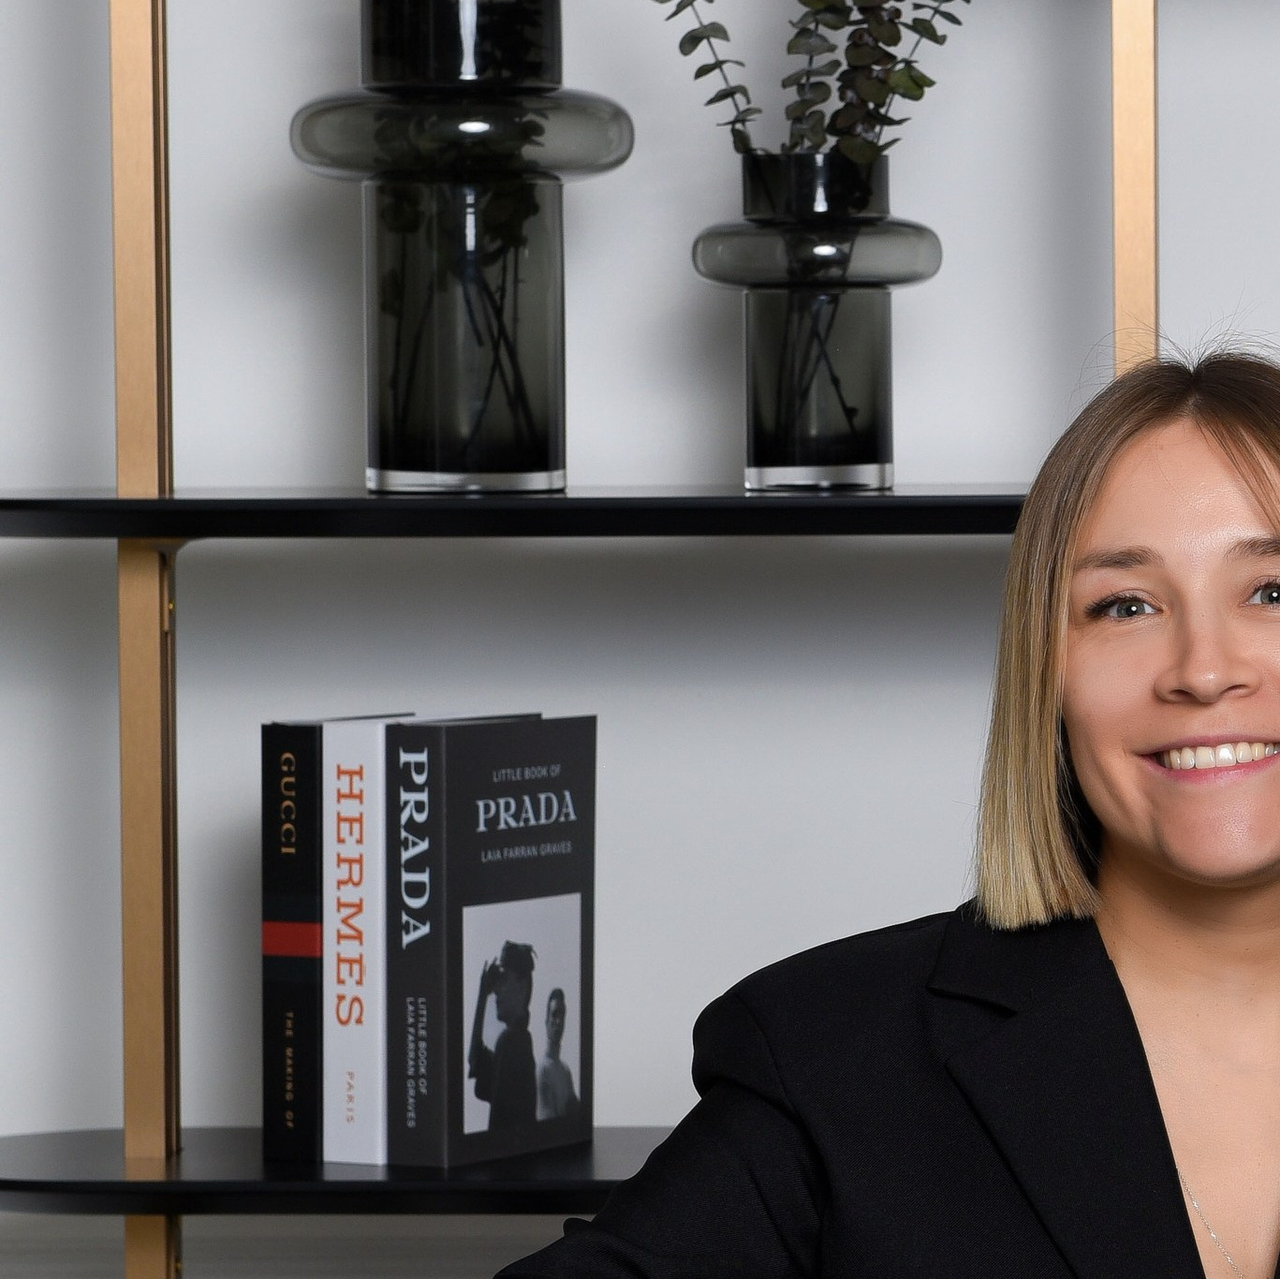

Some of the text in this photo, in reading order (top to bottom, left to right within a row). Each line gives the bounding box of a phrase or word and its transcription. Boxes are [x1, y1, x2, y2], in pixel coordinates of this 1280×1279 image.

[492, 762, 562, 783] LITTLE BOOK OF
[280, 751, 296, 855] GUCCI
[476, 789, 578, 834] PRADA
[399, 746, 432, 951] PRADA
[284, 1010, 294, 1038] THE
[417, 996, 428, 1097] LITTLE BOOK OF
[346, 1070, 356, 1124] PARIS
[406, 1078, 417, 1129] GRAVES
